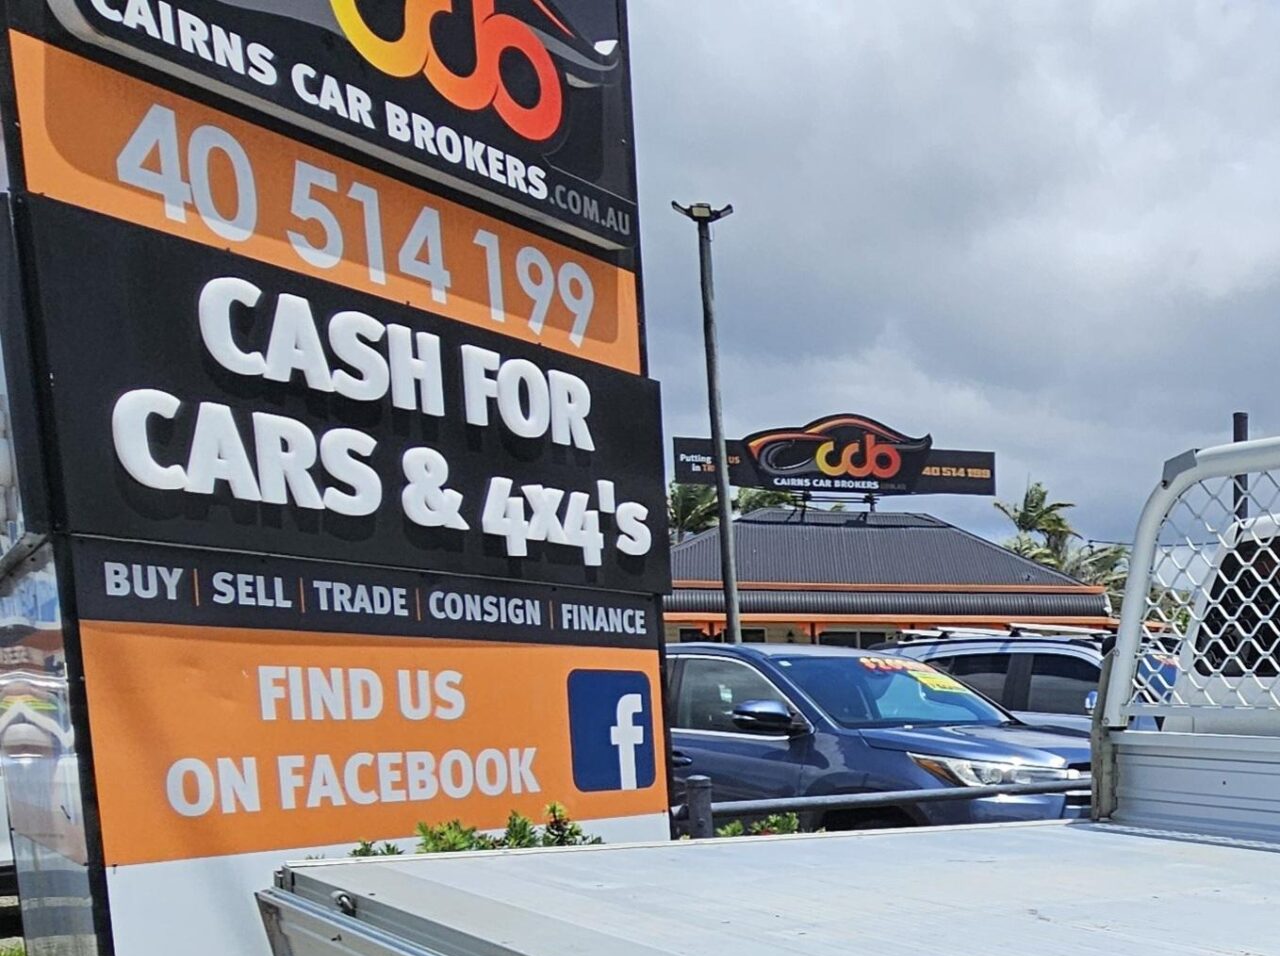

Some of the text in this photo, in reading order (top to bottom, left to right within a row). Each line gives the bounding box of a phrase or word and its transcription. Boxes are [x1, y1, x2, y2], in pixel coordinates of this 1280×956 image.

[291, 63, 375, 129] CAR
[116, 104, 595, 347] 40 514 199
[198, 277, 594, 451] CASH FOR
[111, 388, 382, 516] CARS
[401, 447, 469, 530] &
[774, 477, 810, 486] CAIRNS
[813, 479, 831, 487] CAR
[834, 480, 879, 489] BROKERS
[922, 466, 941, 476] 40
[942, 467, 965, 477] 514
[104, 562, 647, 635] BUY SELL TRADE CONSIGN FINANCE
[258, 665, 465, 721] FIND US
[166, 747, 541, 817] ON FACEBOOK
